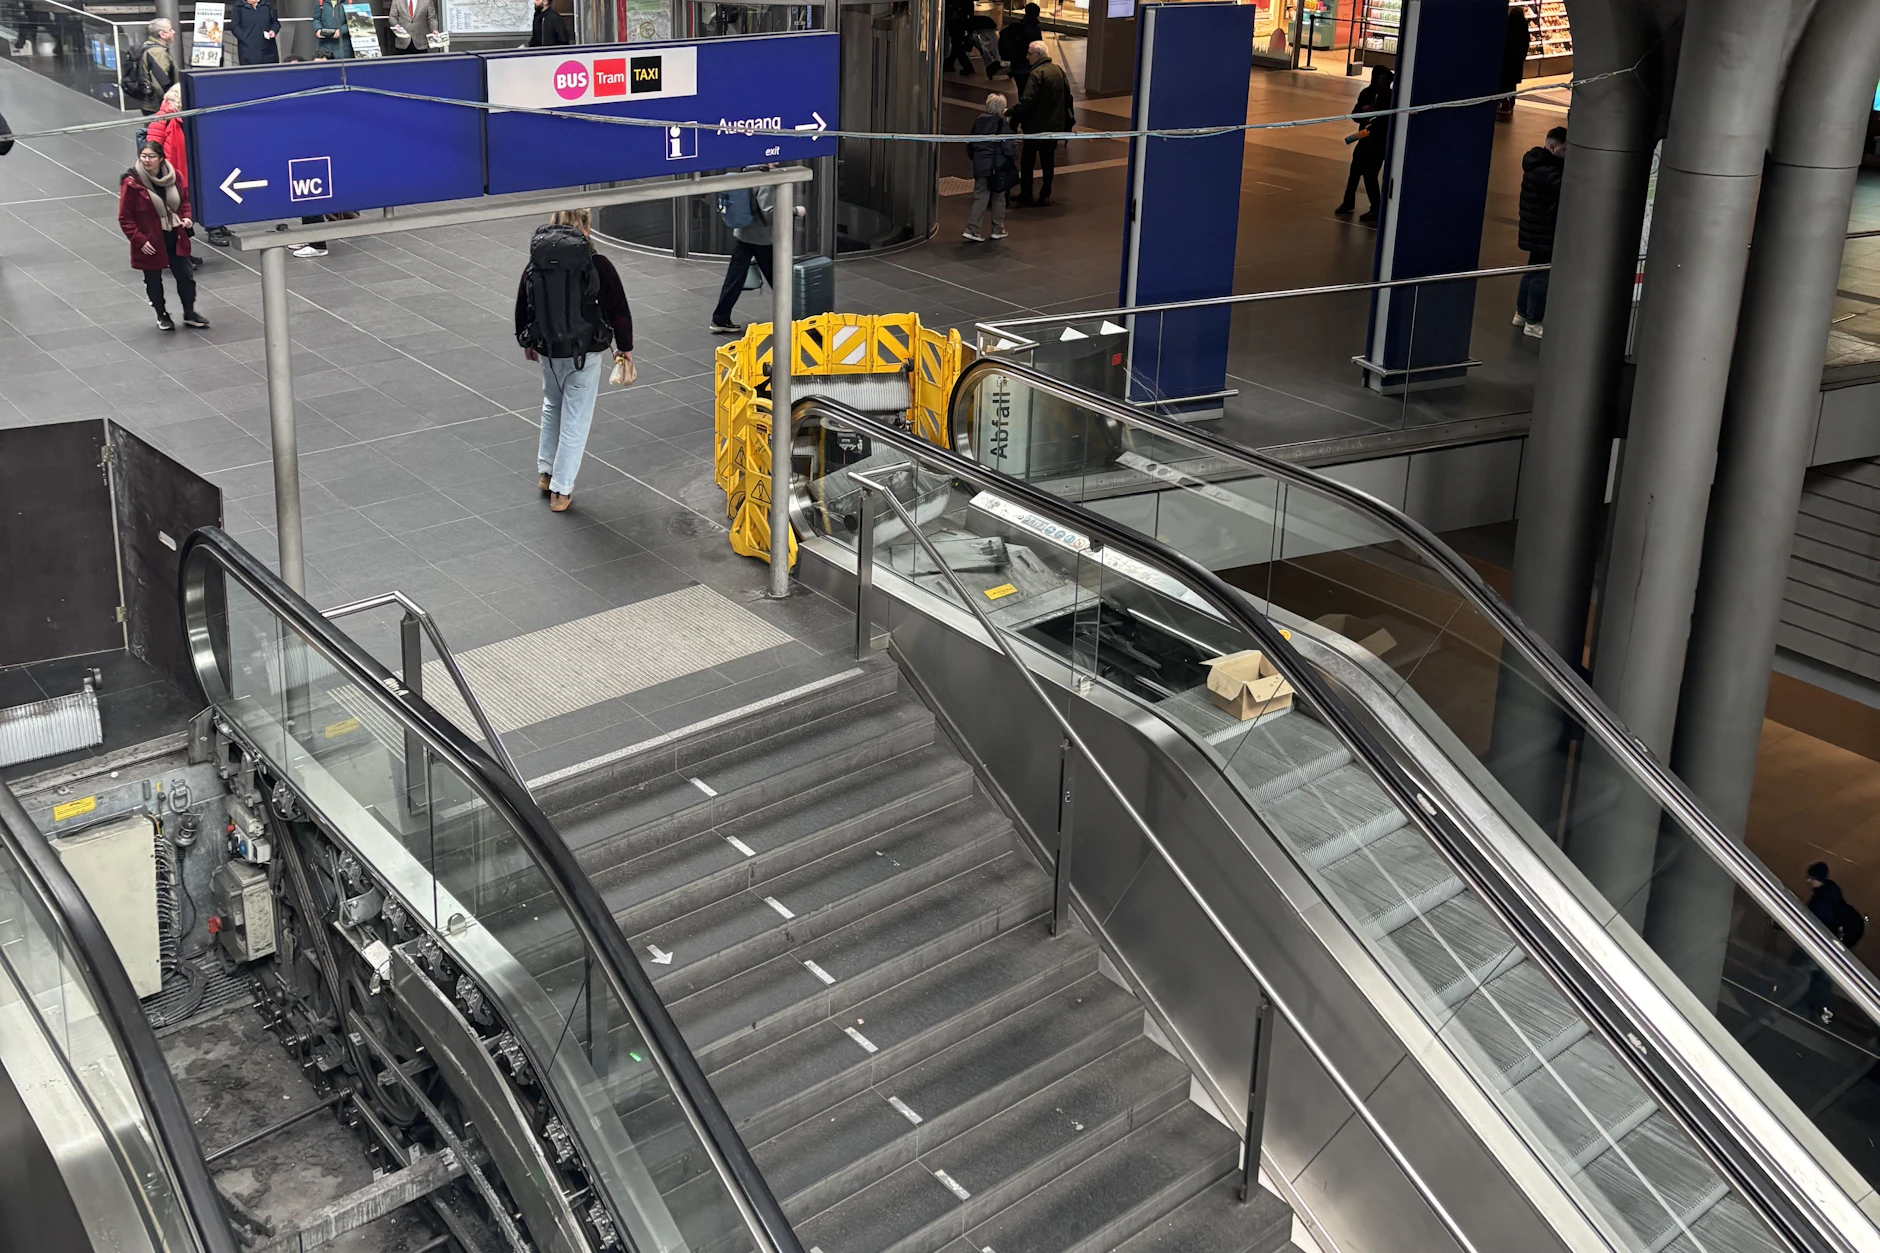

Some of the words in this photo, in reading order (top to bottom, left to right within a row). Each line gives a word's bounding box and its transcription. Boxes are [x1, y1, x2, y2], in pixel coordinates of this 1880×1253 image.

[557, 72, 587, 89] BUS
[596, 72, 625, 84] Tram
[634, 68, 658, 81] TAXI
[765, 145, 780, 156] exit
[293, 178, 322, 195] WC
[990, 392, 1010, 459] Abfall
